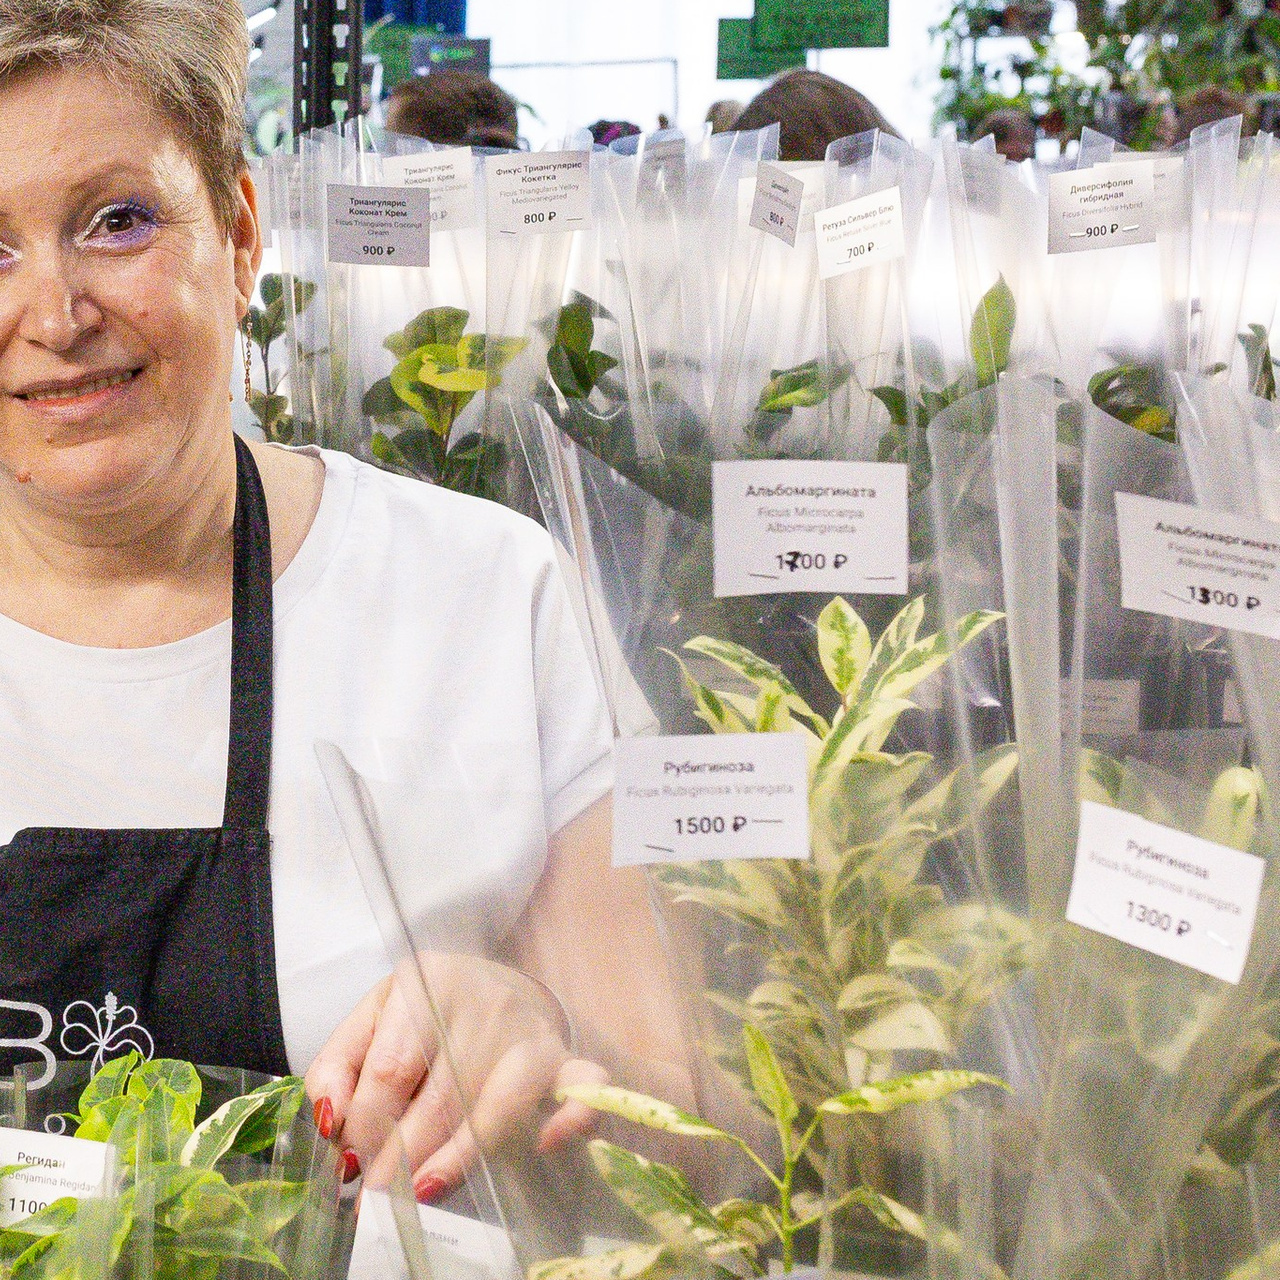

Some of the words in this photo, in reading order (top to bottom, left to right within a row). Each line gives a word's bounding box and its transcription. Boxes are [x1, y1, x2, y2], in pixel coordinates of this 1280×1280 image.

[404, 163, 454, 177] Триангулярис
[496, 165, 521, 176] Фикус
[523, 161, 582, 174] Триангулярис
[521, 173, 557, 183] Кокетка
[1069, 177, 1134, 196] Диверсифолия
[350, 197, 407, 208] Триангулярис
[1079, 190, 1124, 204] гибридная
[348, 208, 383, 218] Коконат
[385, 209, 408, 219] Крем
[523, 212, 545, 225] 800
[822, 218, 848, 232] Ретуза
[847, 210, 878, 226] Сильвер
[878, 204, 895, 216] Блю
[1085, 224, 1108, 238] 900
[362, 245, 384, 256] 900
[847, 243, 866, 259] 700
[745, 483, 877, 499] Альбомаргината
[757, 506, 791, 519] Ficus
[794, 506, 864, 521] Microcarpa
[766, 522, 857, 536] Albomarginata
[1154, 521, 1280, 552] Альбомаргинат
[833, 554, 848, 570] ₽
[1245, 595, 1261, 610] ₽
[663, 760, 755, 777] Рубигиноза
[675, 816, 726, 835] 1500
[732, 816, 747, 833] ₽
[1126, 839, 1210, 881] Рубигиноза
[1125, 900, 1172, 932] 1300
[16, 1150, 66, 1172] Регидан
